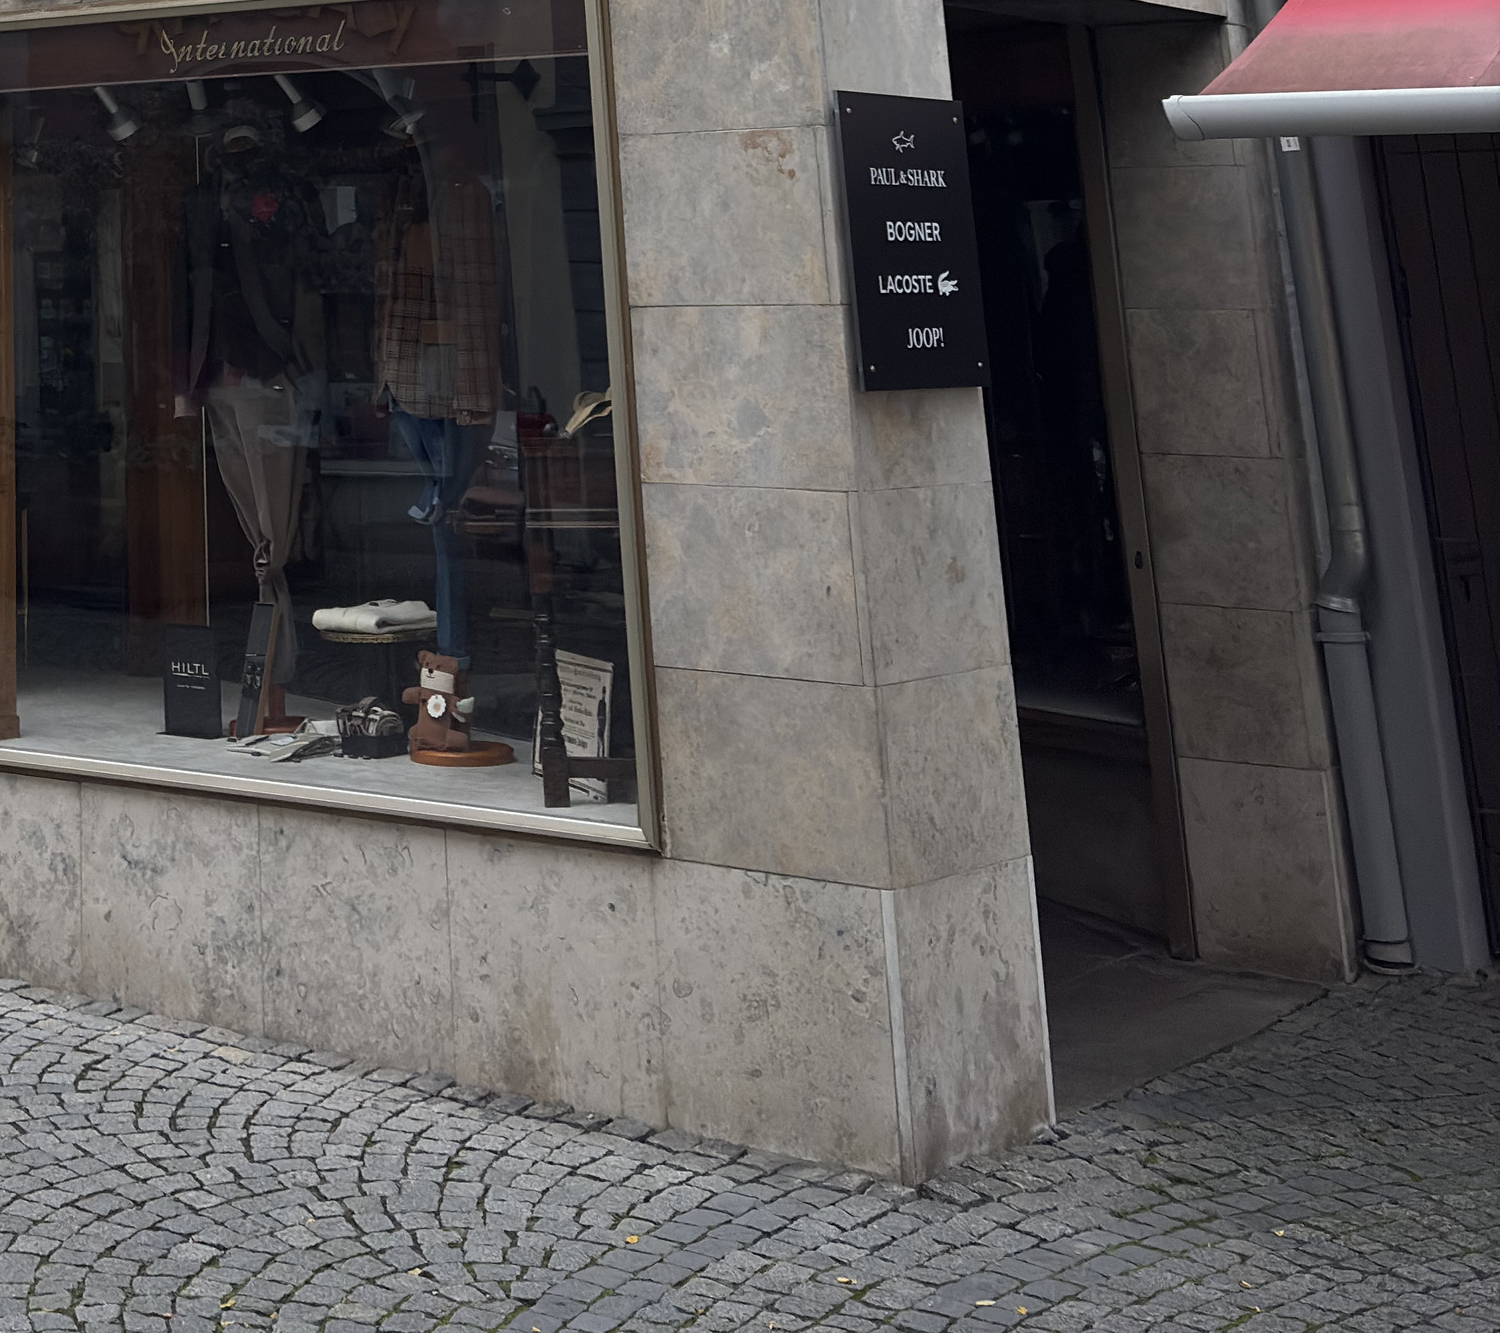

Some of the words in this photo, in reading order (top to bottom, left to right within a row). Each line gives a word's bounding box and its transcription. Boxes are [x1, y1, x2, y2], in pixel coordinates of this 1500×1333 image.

[160, 19, 346, 74] International
[886, 221, 942, 242] BOGNER
[878, 275, 934, 294] LACOSTE
[907, 327, 945, 349] JOOP!
[171, 661, 210, 676] HILTL
